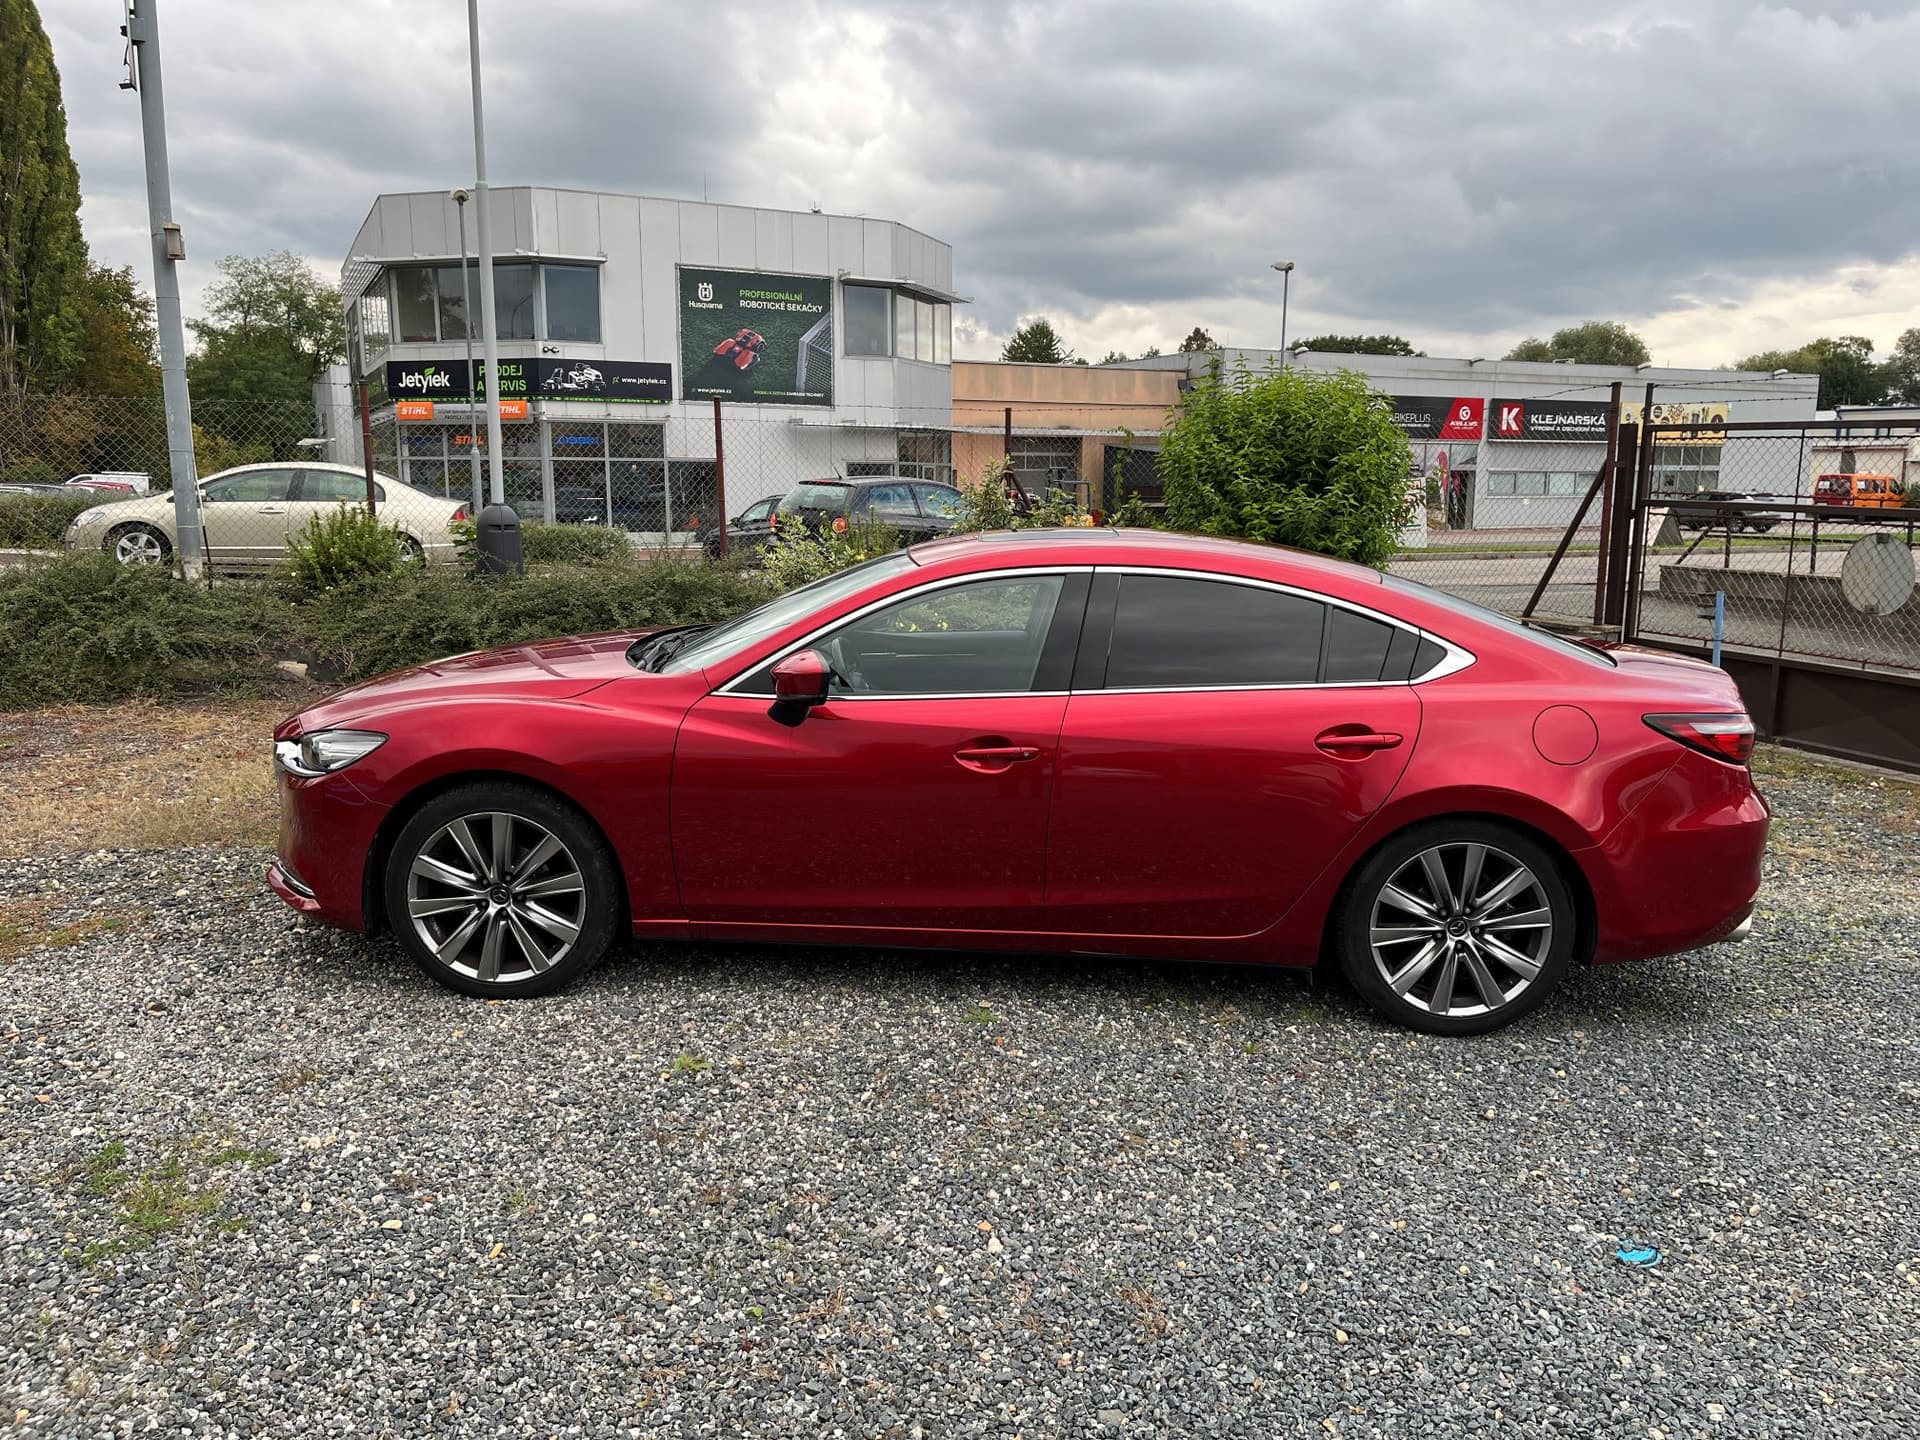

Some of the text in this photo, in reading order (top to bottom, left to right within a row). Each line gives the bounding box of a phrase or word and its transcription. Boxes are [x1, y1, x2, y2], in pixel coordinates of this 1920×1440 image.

[739, 289, 803, 301] PROFESIONÁLNÍ
[688, 300, 723, 310] Husqvarna
[739, 300, 823, 313] ROBOTICKÉ SEKAČKY
[478, 364, 523, 377] PODEJ
[476, 380, 485, 391] A
[401, 406, 428, 415] STIHL
[499, 405, 522, 414] TIHL
[1502, 407, 1520, 431] K
[1530, 413, 1606, 426] KLEJNARSKÁ
[454, 435, 485, 446] STIL
